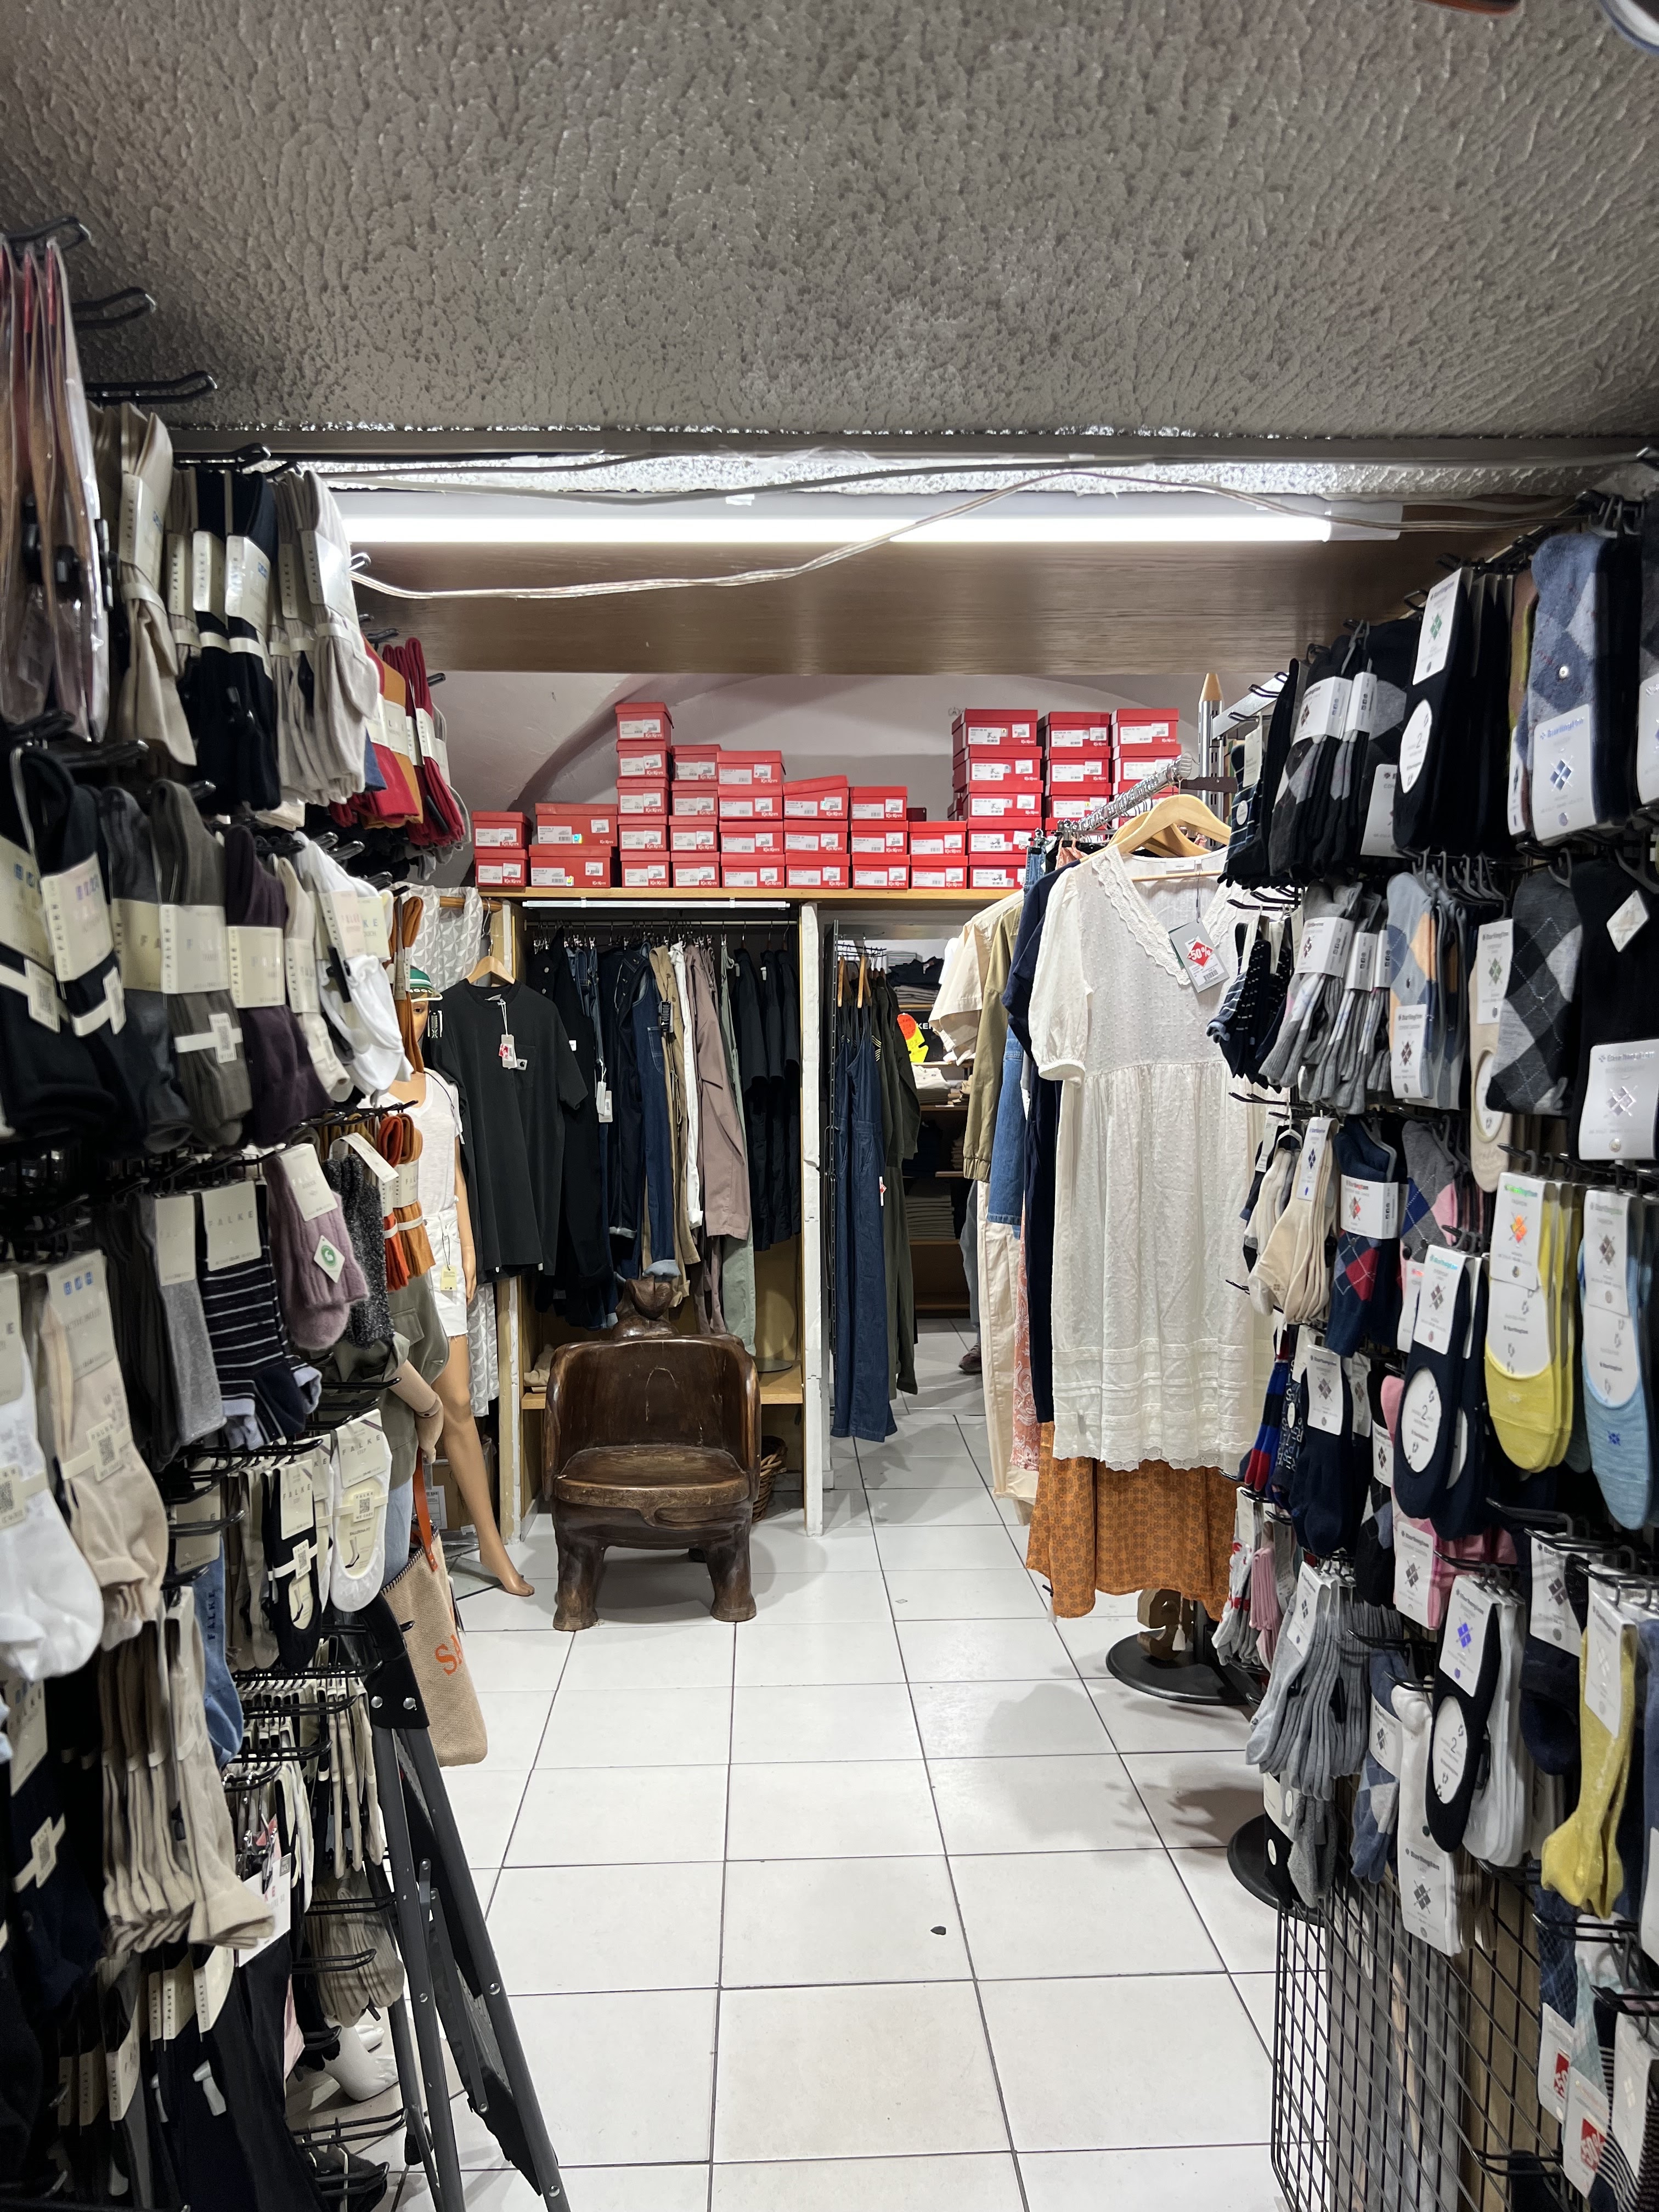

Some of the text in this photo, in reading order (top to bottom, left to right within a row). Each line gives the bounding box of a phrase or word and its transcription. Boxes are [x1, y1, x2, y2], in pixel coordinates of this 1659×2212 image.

[309, 550, 317, 583] FALKE
[1547, 717, 1584, 738] Burlington
[1416, 732, 1423, 749] 2
[327, 910, 338, 940] FALKE
[1188, 945, 1211, 961] -50%
[289, 958, 297, 991] FALKE
[208, 1210, 254, 1229] FALKE
[1421, 1404, 1428, 1421] 2
[342, 1434, 381, 1455] FALKE
[283, 1483, 311, 1500] FALKE
[207, 1589, 216, 1640] FALKE
[1451, 1736, 1457, 1754] 2
[1410, 1850, 1440, 1871] Burlington
